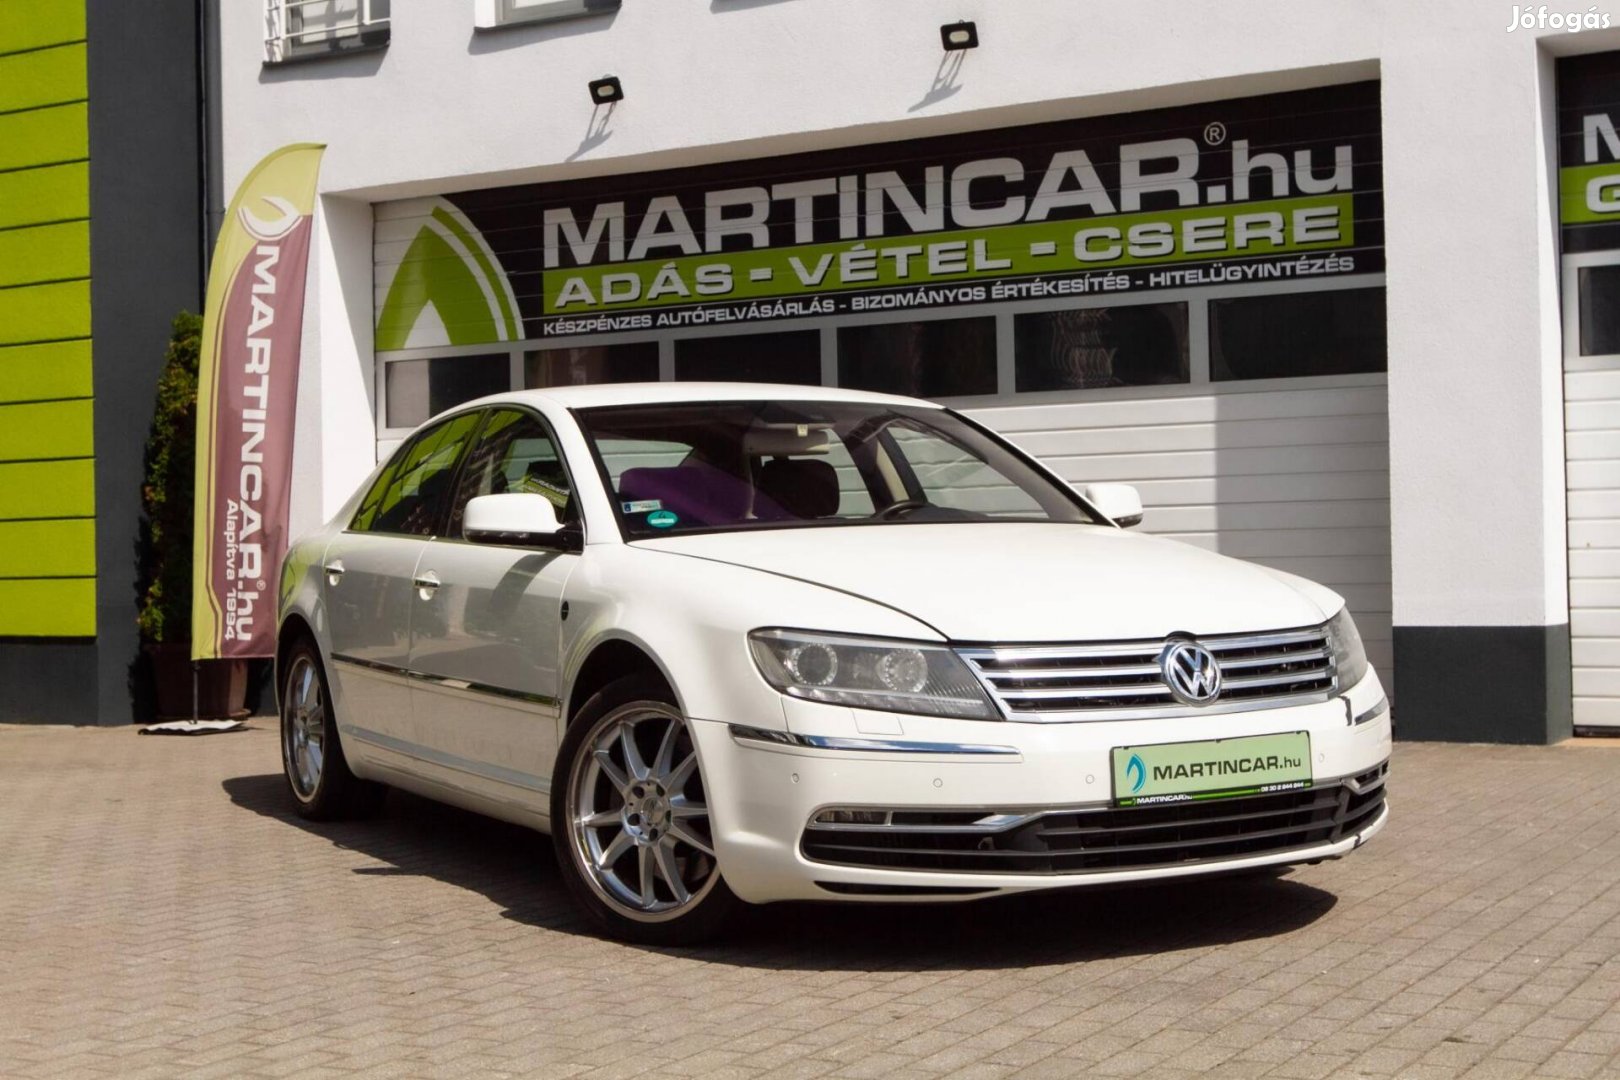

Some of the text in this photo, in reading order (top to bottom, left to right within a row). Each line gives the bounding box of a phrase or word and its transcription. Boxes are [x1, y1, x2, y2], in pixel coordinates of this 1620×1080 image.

[543, 315, 652, 336] KÉSZPÉNZES
[656, 298, 835, 327] AUTÓFELVÁSÁRLÁS
[851, 286, 986, 312] BIZOMÁNYOS
[991, 273, 1130, 299] ÉRTÉKESÍTÉS
[1149, 251, 1355, 288] HITELÜGYINTÉZÉS
[554, 261, 734, 308] ADÁS
[788, 240, 1012, 287] VÉTEL
[1073, 206, 1341, 263] CSERE
[224, 499, 239, 580] Alapítva
[1153, 755, 1301, 781] MARTINCAR.hu
